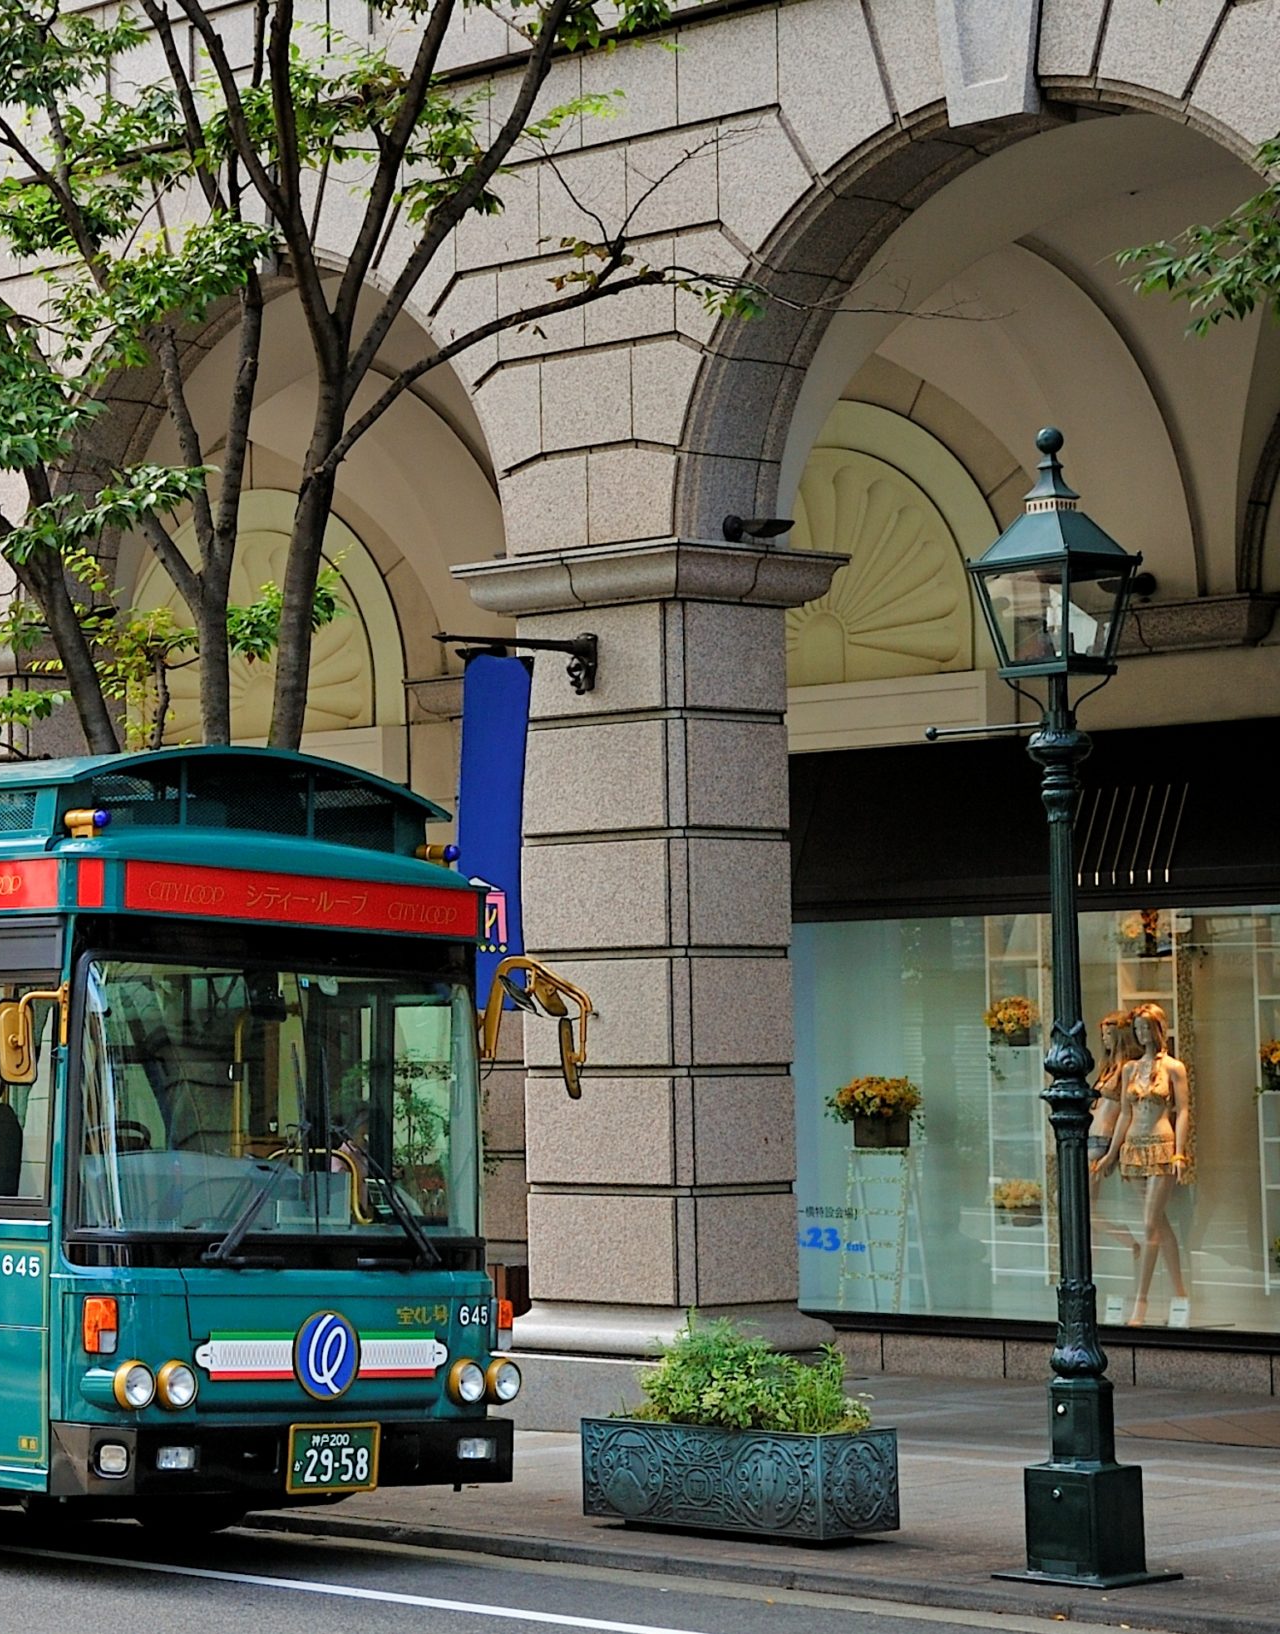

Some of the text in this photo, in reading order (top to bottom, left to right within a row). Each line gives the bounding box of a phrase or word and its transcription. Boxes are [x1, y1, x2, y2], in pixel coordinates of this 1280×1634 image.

[148, 880, 225, 905] CITY LOOP
[246, 884, 369, 915] シティー・ループ
[387, 901, 457, 925] CITY LOOP
[1, 1254, 41, 1277] 645
[460, 1305, 488, 1326] 645
[303, 1447, 369, 1483] 29-58
